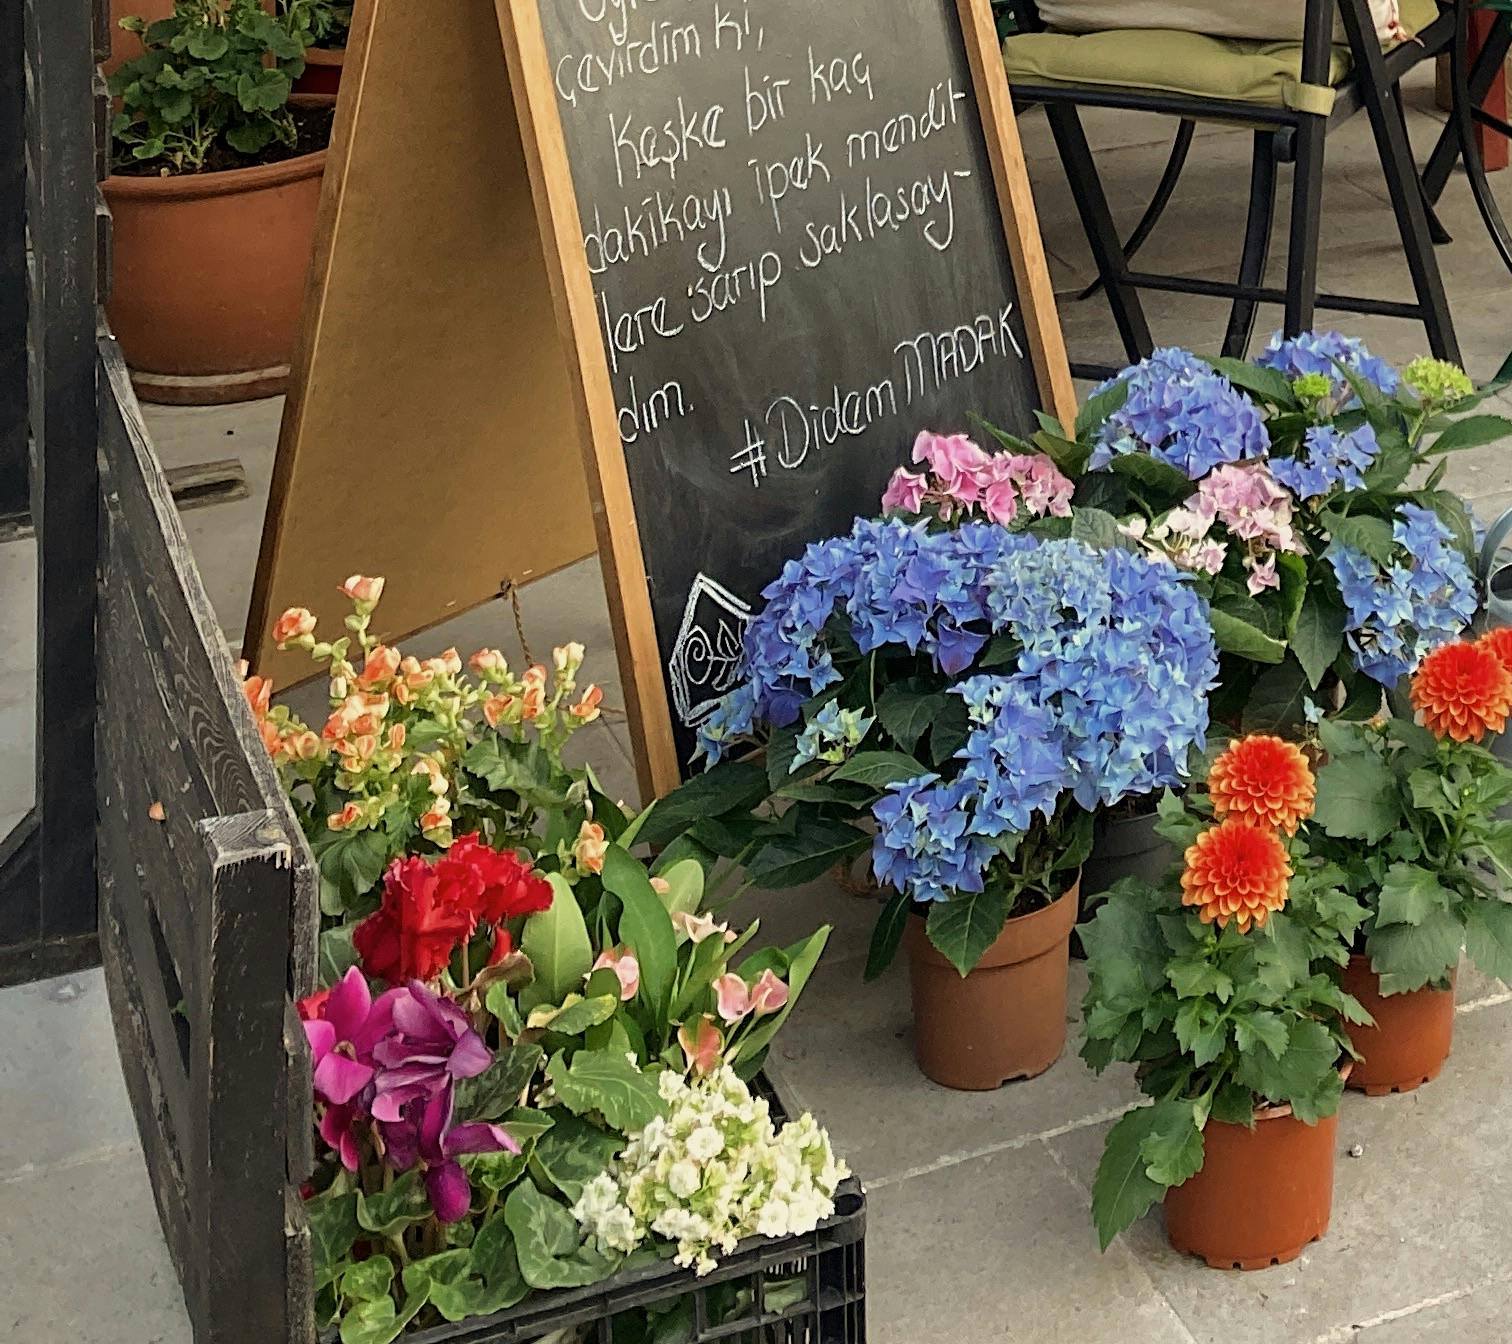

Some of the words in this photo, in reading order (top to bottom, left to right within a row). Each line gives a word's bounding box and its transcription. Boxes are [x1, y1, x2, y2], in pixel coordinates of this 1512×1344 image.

[745, 65, 791, 135] bir
[809, 45, 873, 104] kaç
[584, 188, 732, 273] dakikayı
[748, 133, 831, 233] ipek
[601, 291, 684, 373] lere
[730, 379, 896, 488] #Didem
[894, 302, 1023, 405] MADAK
